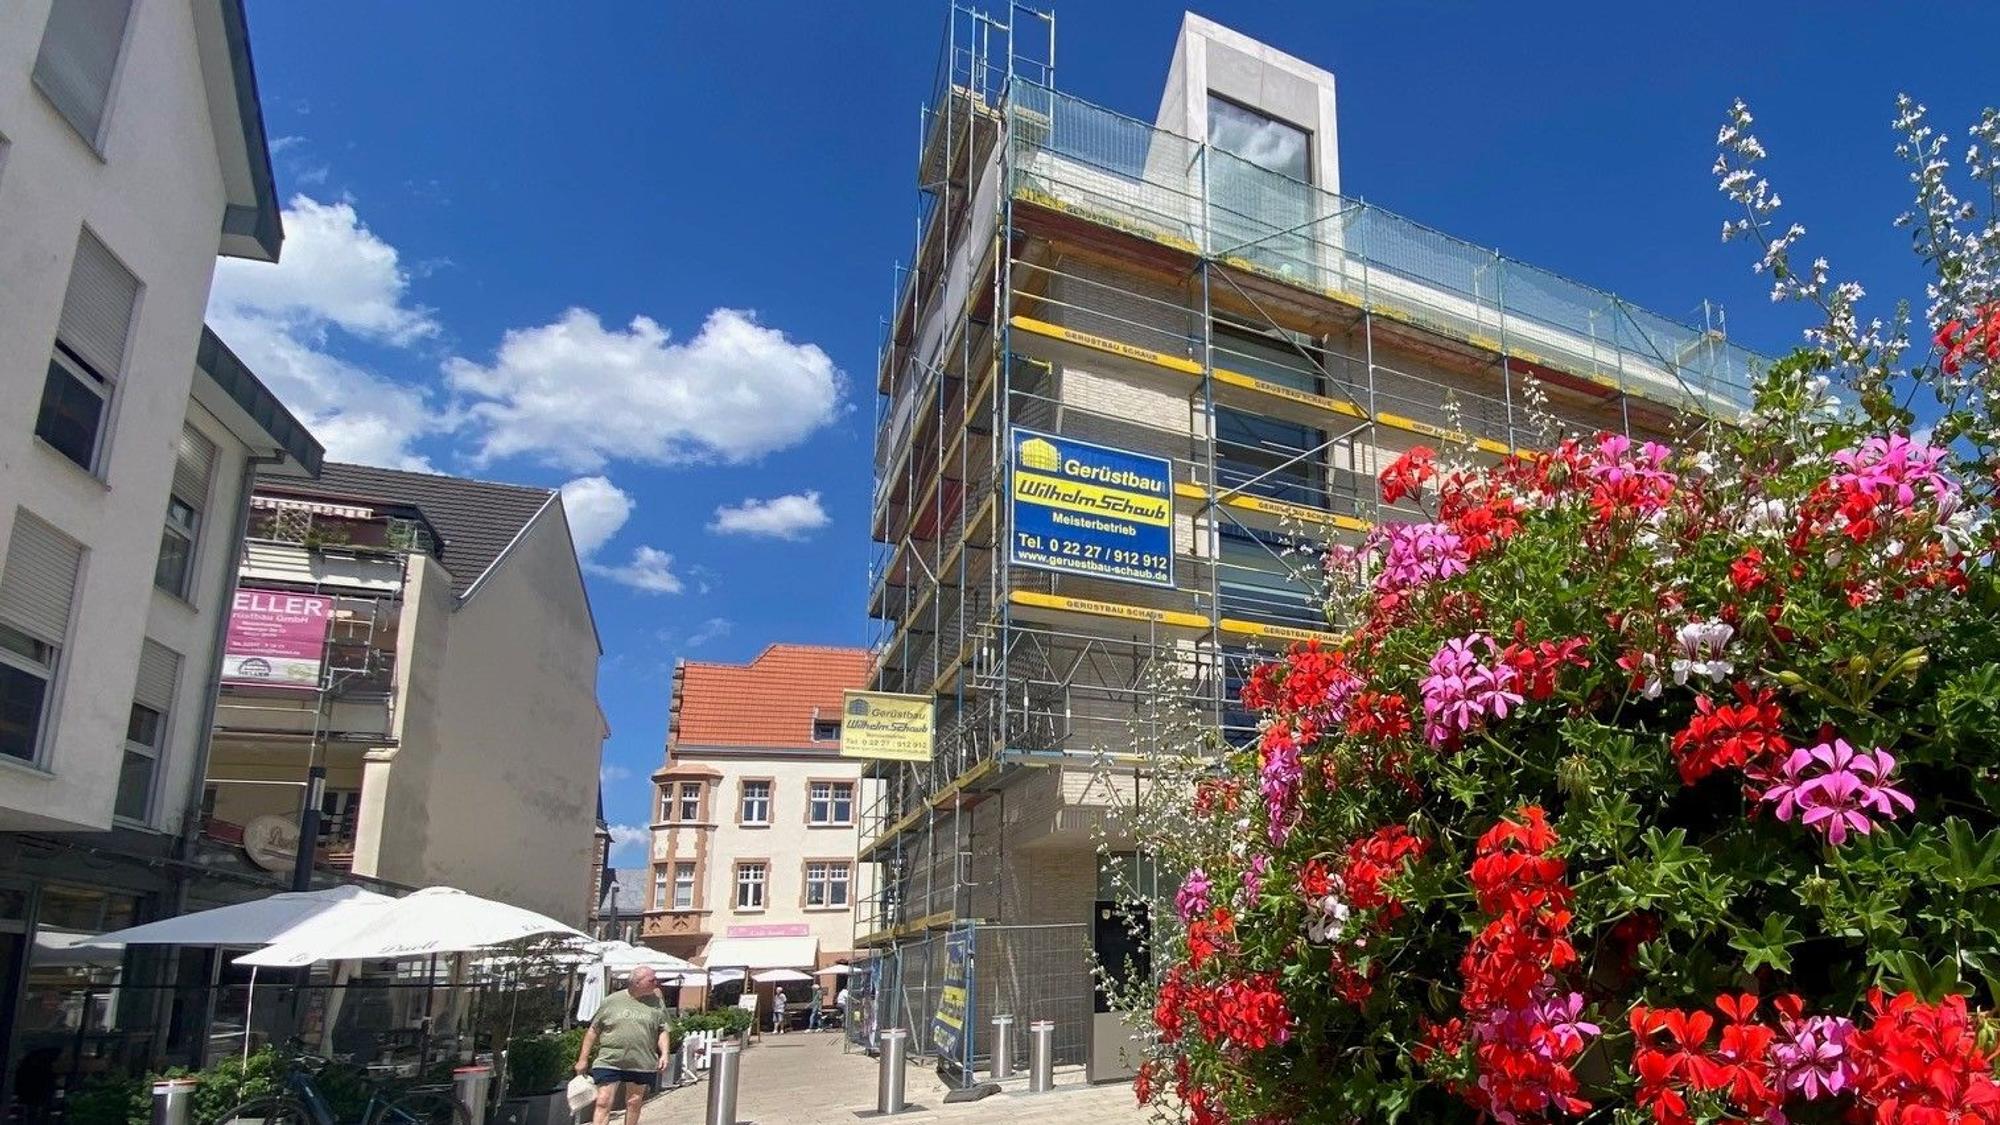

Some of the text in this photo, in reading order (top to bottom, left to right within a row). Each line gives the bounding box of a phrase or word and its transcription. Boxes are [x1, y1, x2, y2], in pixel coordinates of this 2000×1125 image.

[1064, 459, 1162, 492] Gerüstbau
[1052, 512, 1137, 536] Meisterbetrieb
[1018, 533, 1167, 569] Tel. 0 22 27 / 912 912
[1018, 550, 1168, 582] www.geruestbau-schaub.de
[871, 708, 926, 720] Gerüstbau
